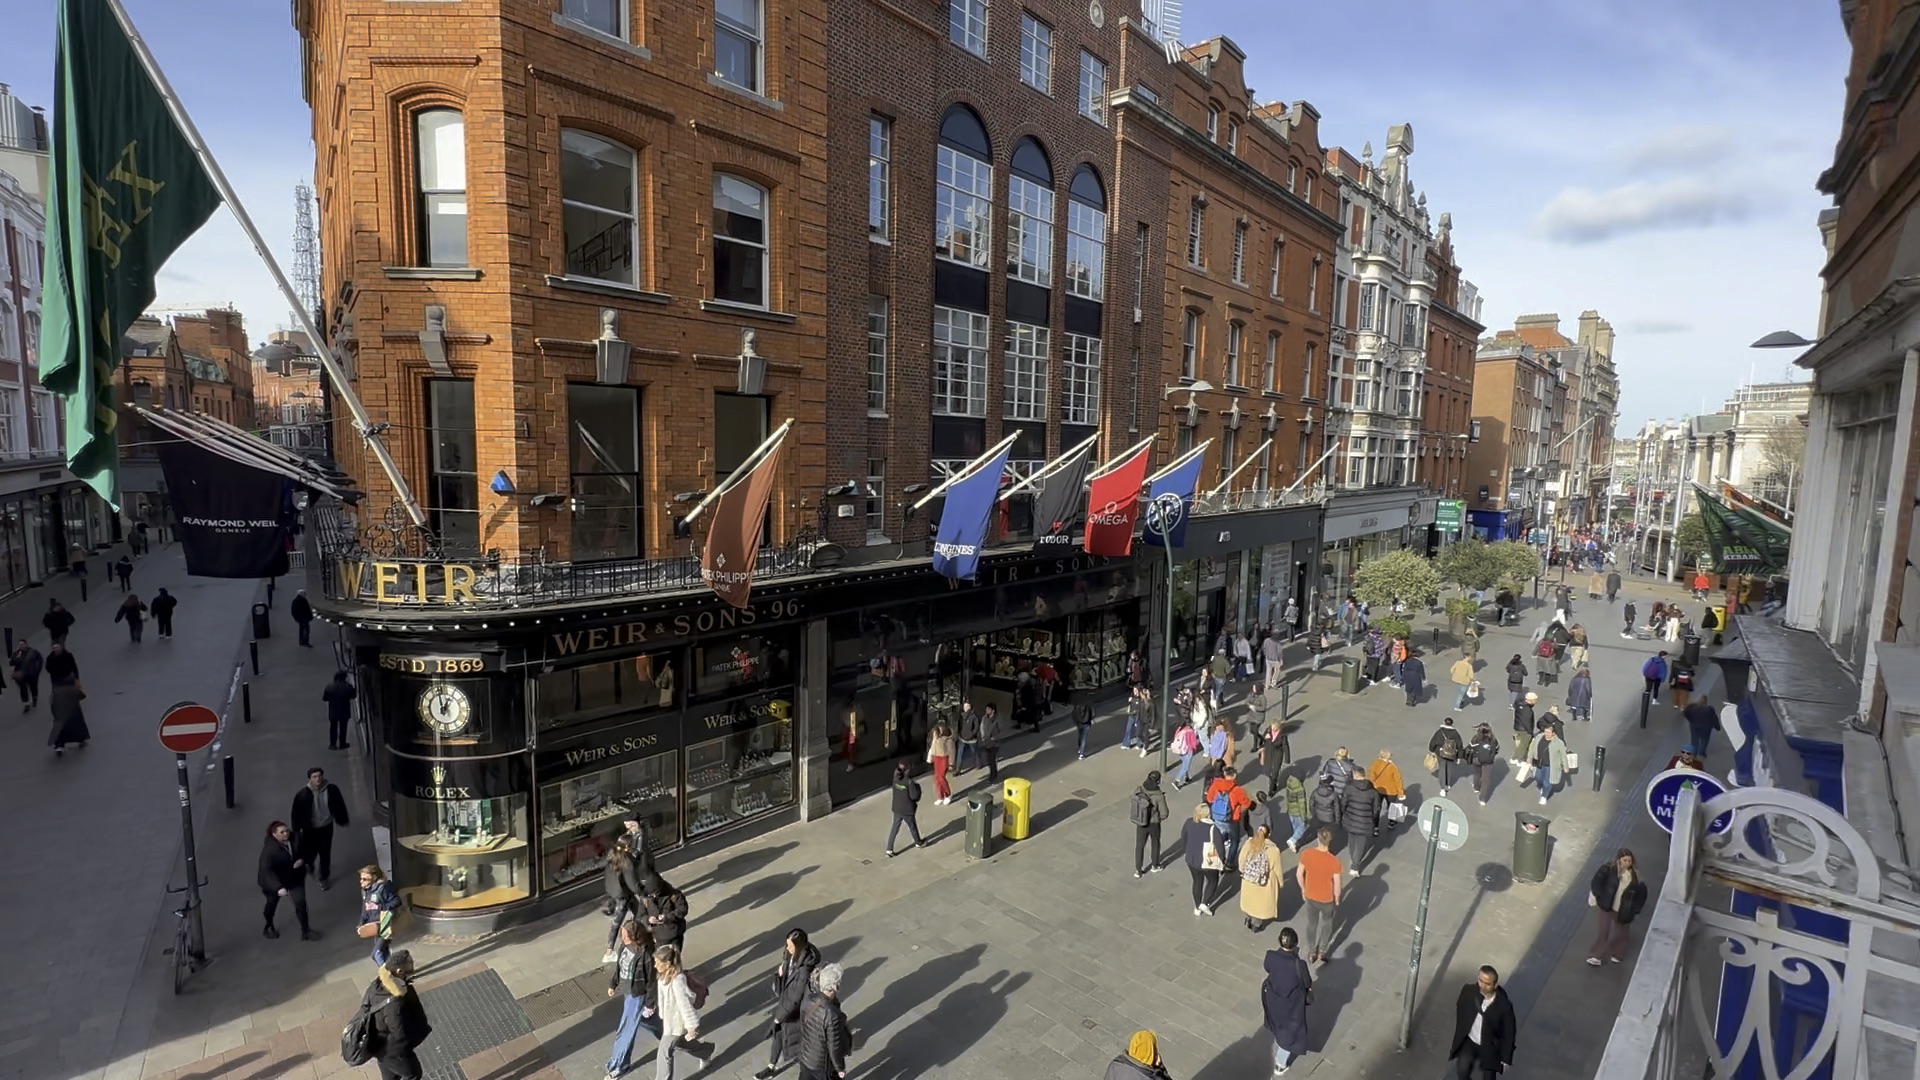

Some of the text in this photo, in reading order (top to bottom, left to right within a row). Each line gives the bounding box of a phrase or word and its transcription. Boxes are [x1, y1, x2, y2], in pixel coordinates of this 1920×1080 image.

[182, 516, 279, 527] RAYMOND WEIL
[1088, 513, 1129, 525] OMEGA
[338, 561, 480, 603] WEIR
[553, 598, 799, 655] WEIR & SONS 96
[436, 658, 484, 673] 1869
[711, 662, 732, 672] PATEK
[704, 714, 737, 730] WEIR
[564, 733, 658, 766] WEIR & SONS
[415, 785, 471, 799] ROLEX
